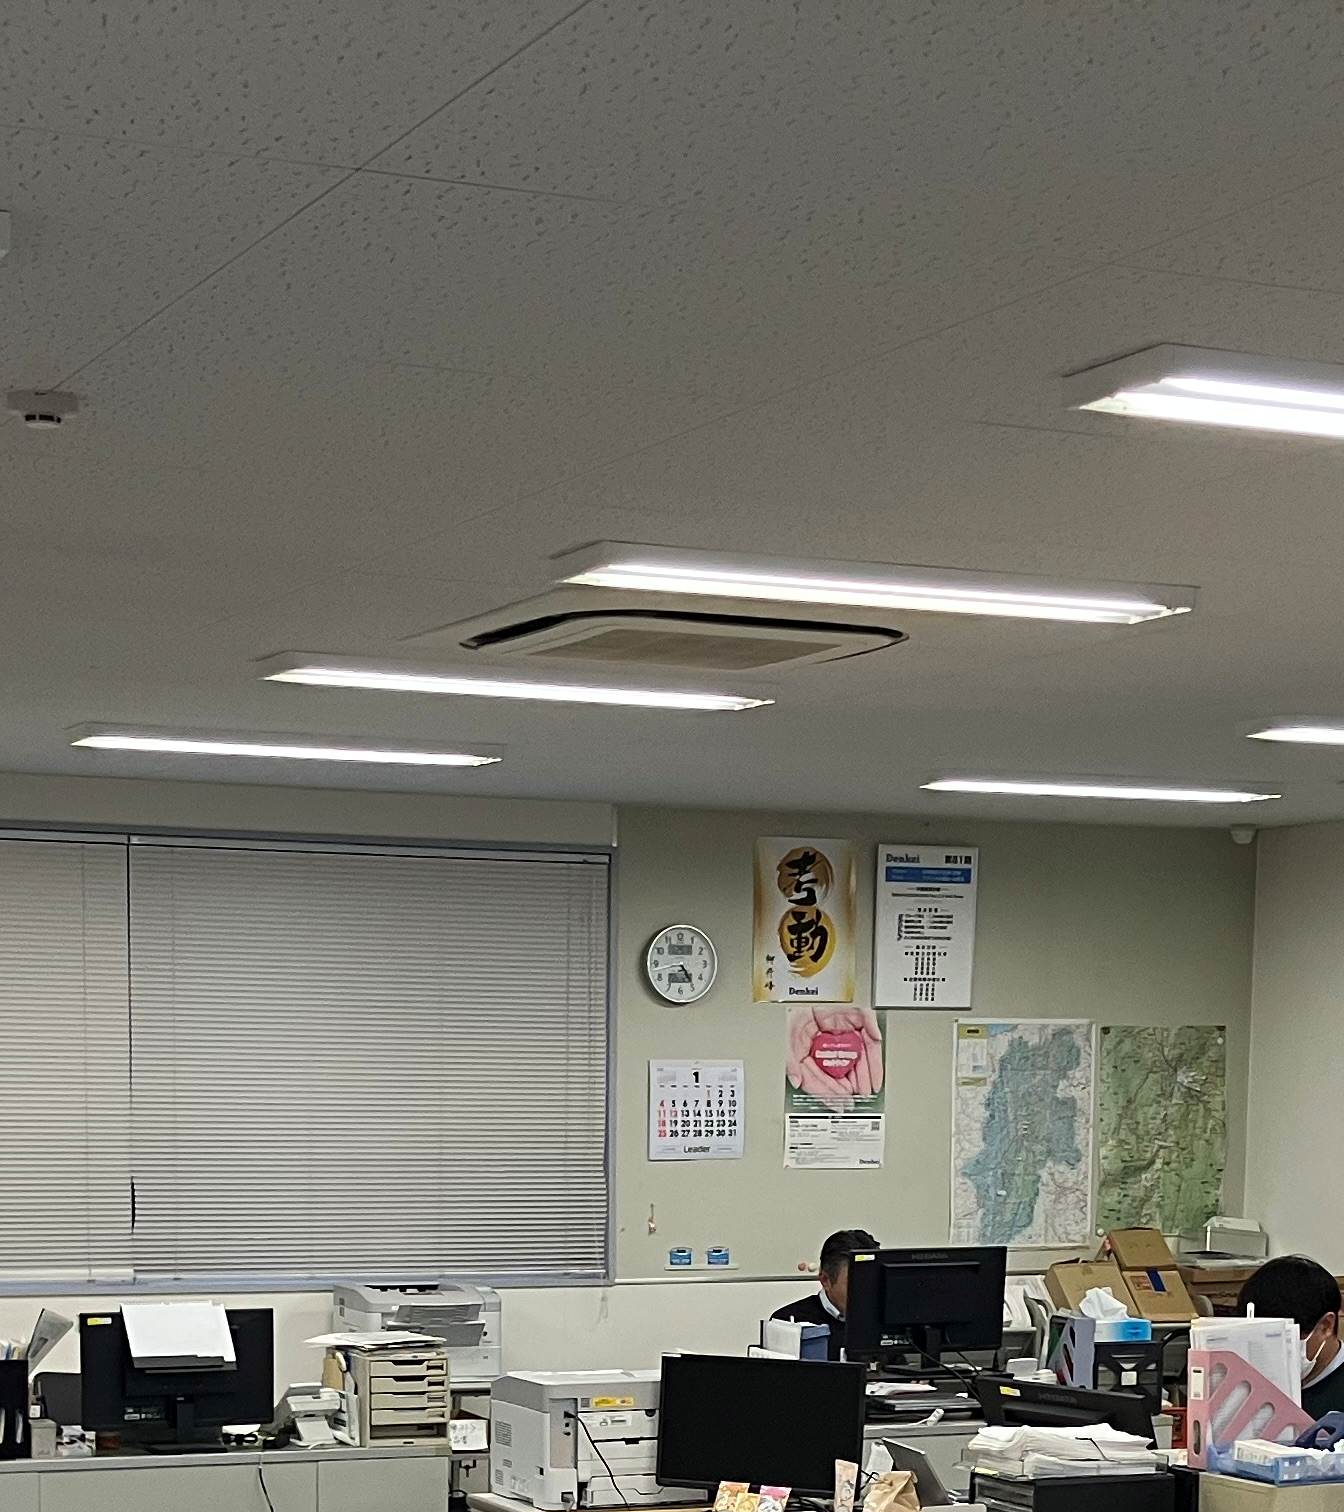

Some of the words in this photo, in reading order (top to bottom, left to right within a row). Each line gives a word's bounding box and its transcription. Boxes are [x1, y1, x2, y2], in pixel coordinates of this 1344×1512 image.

[886, 853, 920, 864] Denkei
[788, 987, 819, 996] Denkei
[693, 1072, 699, 1083] 1
